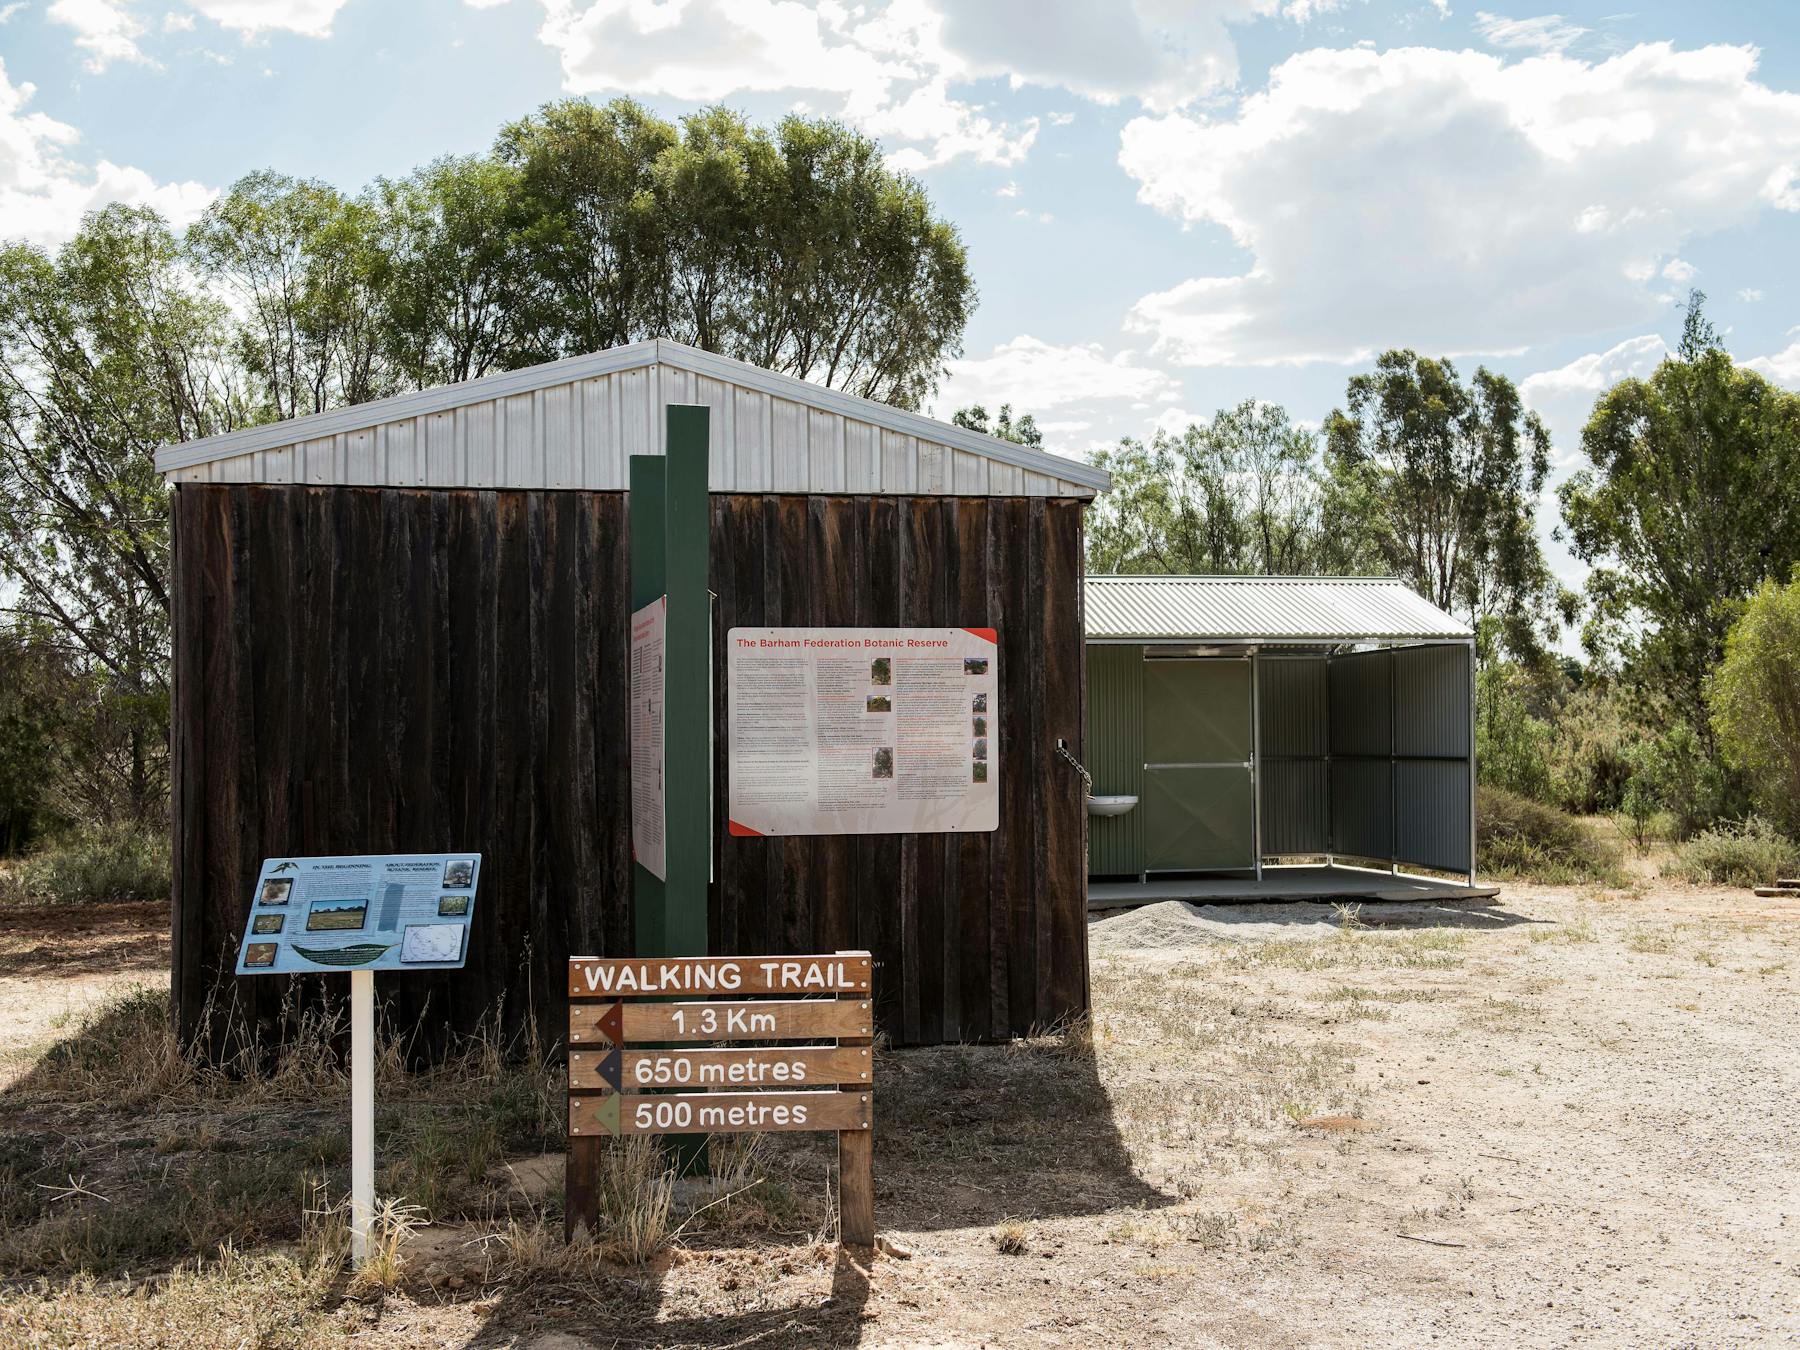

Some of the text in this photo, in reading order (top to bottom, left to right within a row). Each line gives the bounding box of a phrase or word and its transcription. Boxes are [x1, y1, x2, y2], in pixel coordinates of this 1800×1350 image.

[737, 639, 950, 648] The Barham Federation Botanic Reserve
[584, 962, 855, 992] WALKING TRAIL
[672, 1008, 776, 1034] 1.3 Km
[635, 1058, 807, 1084] 650 metres
[635, 1101, 808, 1129] 500 metres
